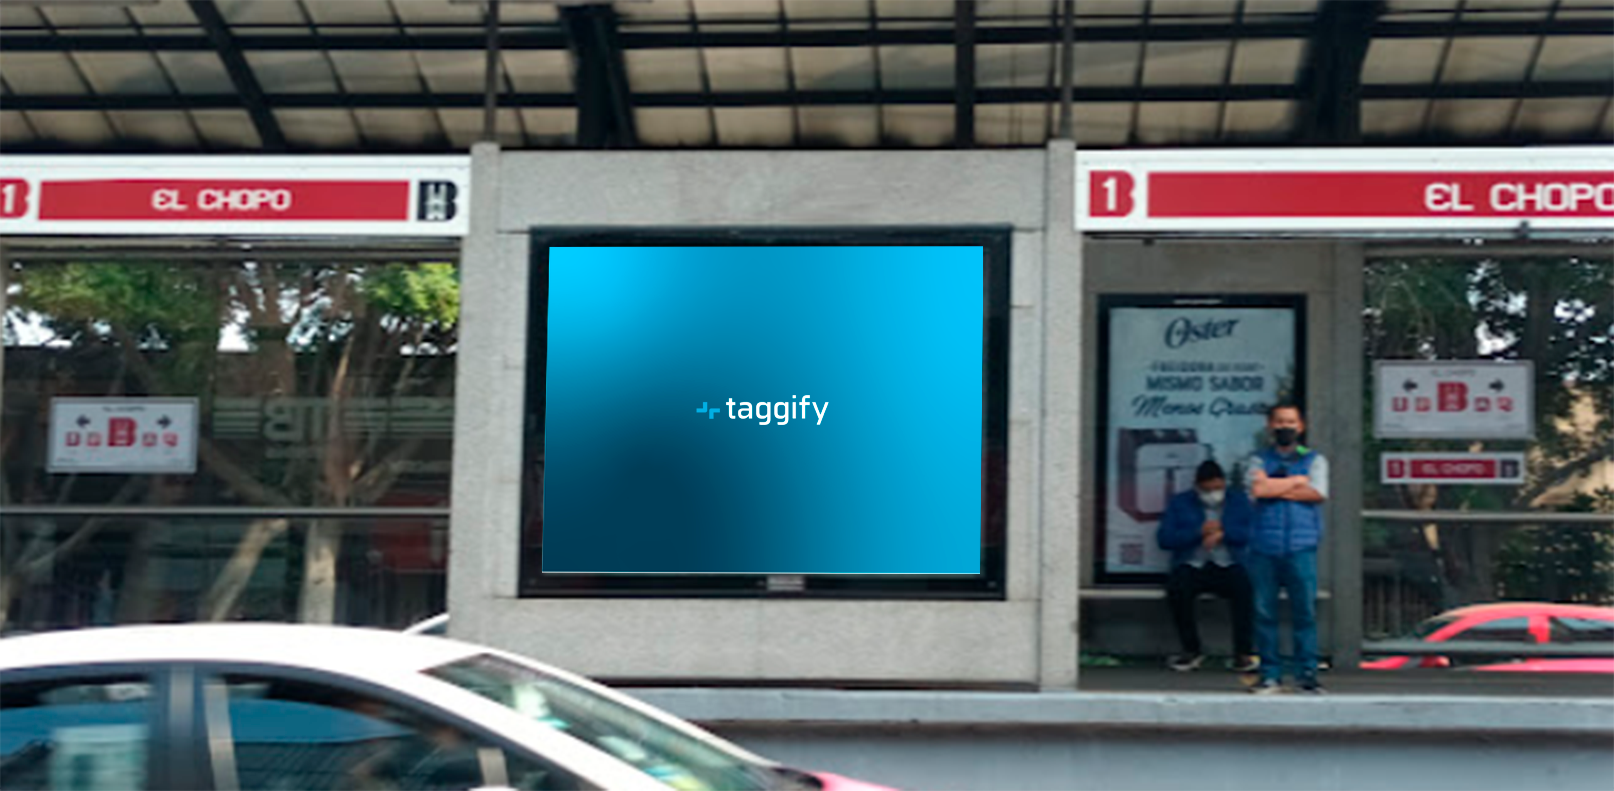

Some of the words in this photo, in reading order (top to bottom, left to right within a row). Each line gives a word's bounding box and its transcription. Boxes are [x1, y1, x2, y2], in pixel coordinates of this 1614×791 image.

[2, 184, 16, 213] 1
[151, 188, 188, 212] EL
[196, 188, 293, 212] CHOPO
[1102, 177, 1118, 211] 1
[1425, 182, 1474, 211] EL
[1164, 316, 1240, 349] Oster
[1145, 375, 1203, 393] MISMO
[1208, 375, 1265, 393] SABOR
[725, 395, 829, 425] taggify
